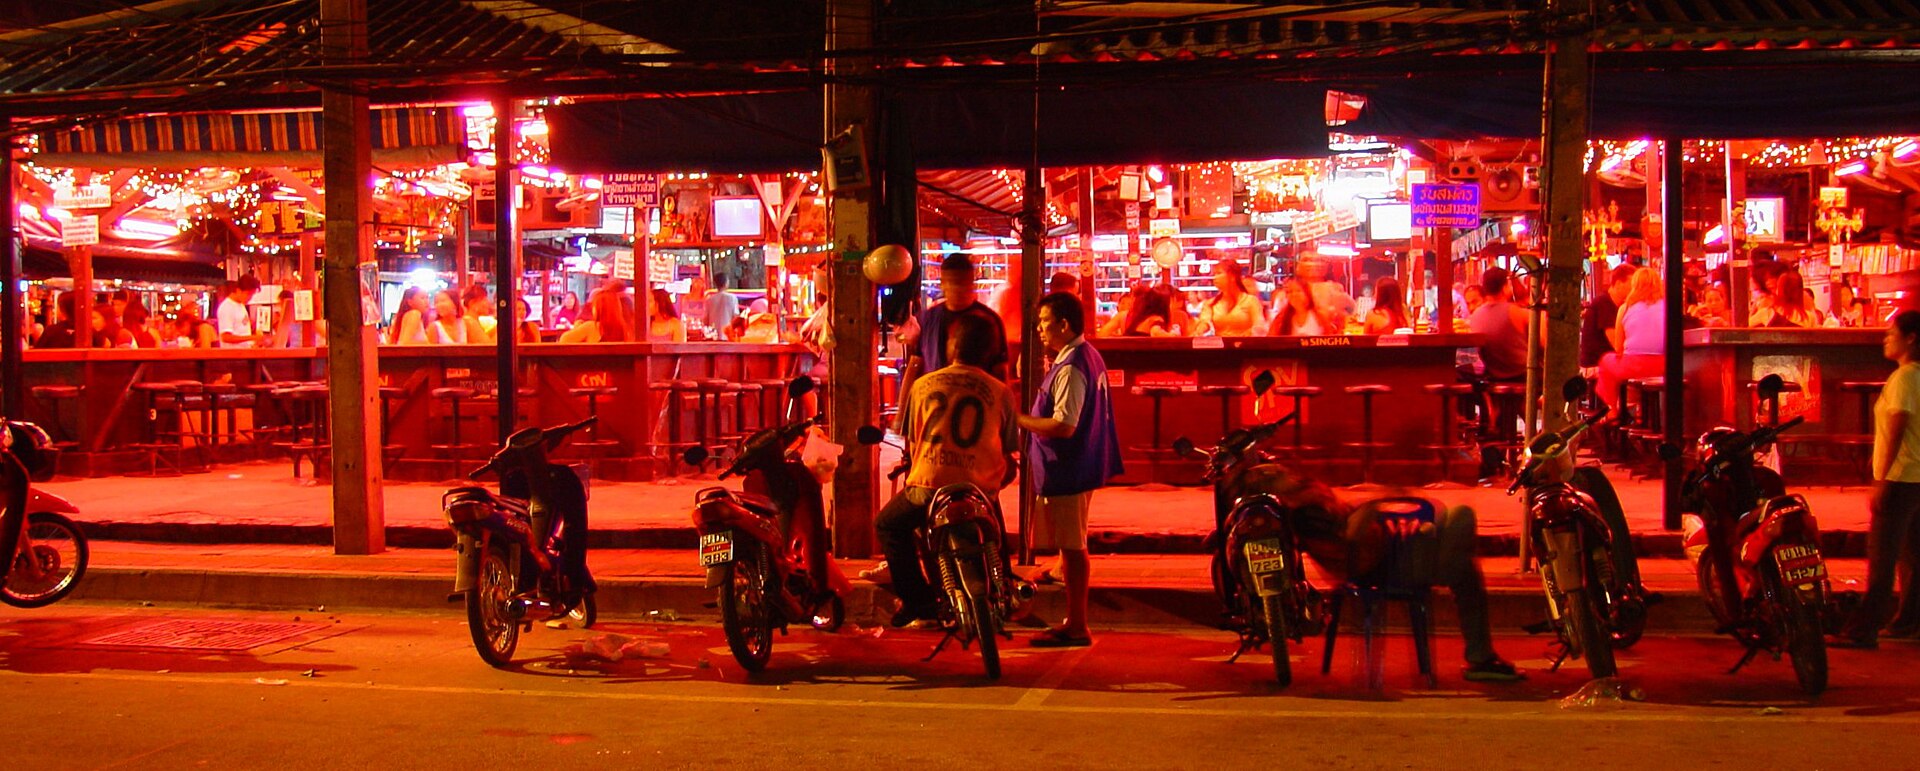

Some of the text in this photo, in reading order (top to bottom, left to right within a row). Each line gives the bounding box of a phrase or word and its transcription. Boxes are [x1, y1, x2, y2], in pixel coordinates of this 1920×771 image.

[1309, 337, 1350, 346] SINGHA
[924, 390, 984, 449] 20
[1253, 560, 1280, 573] 723
